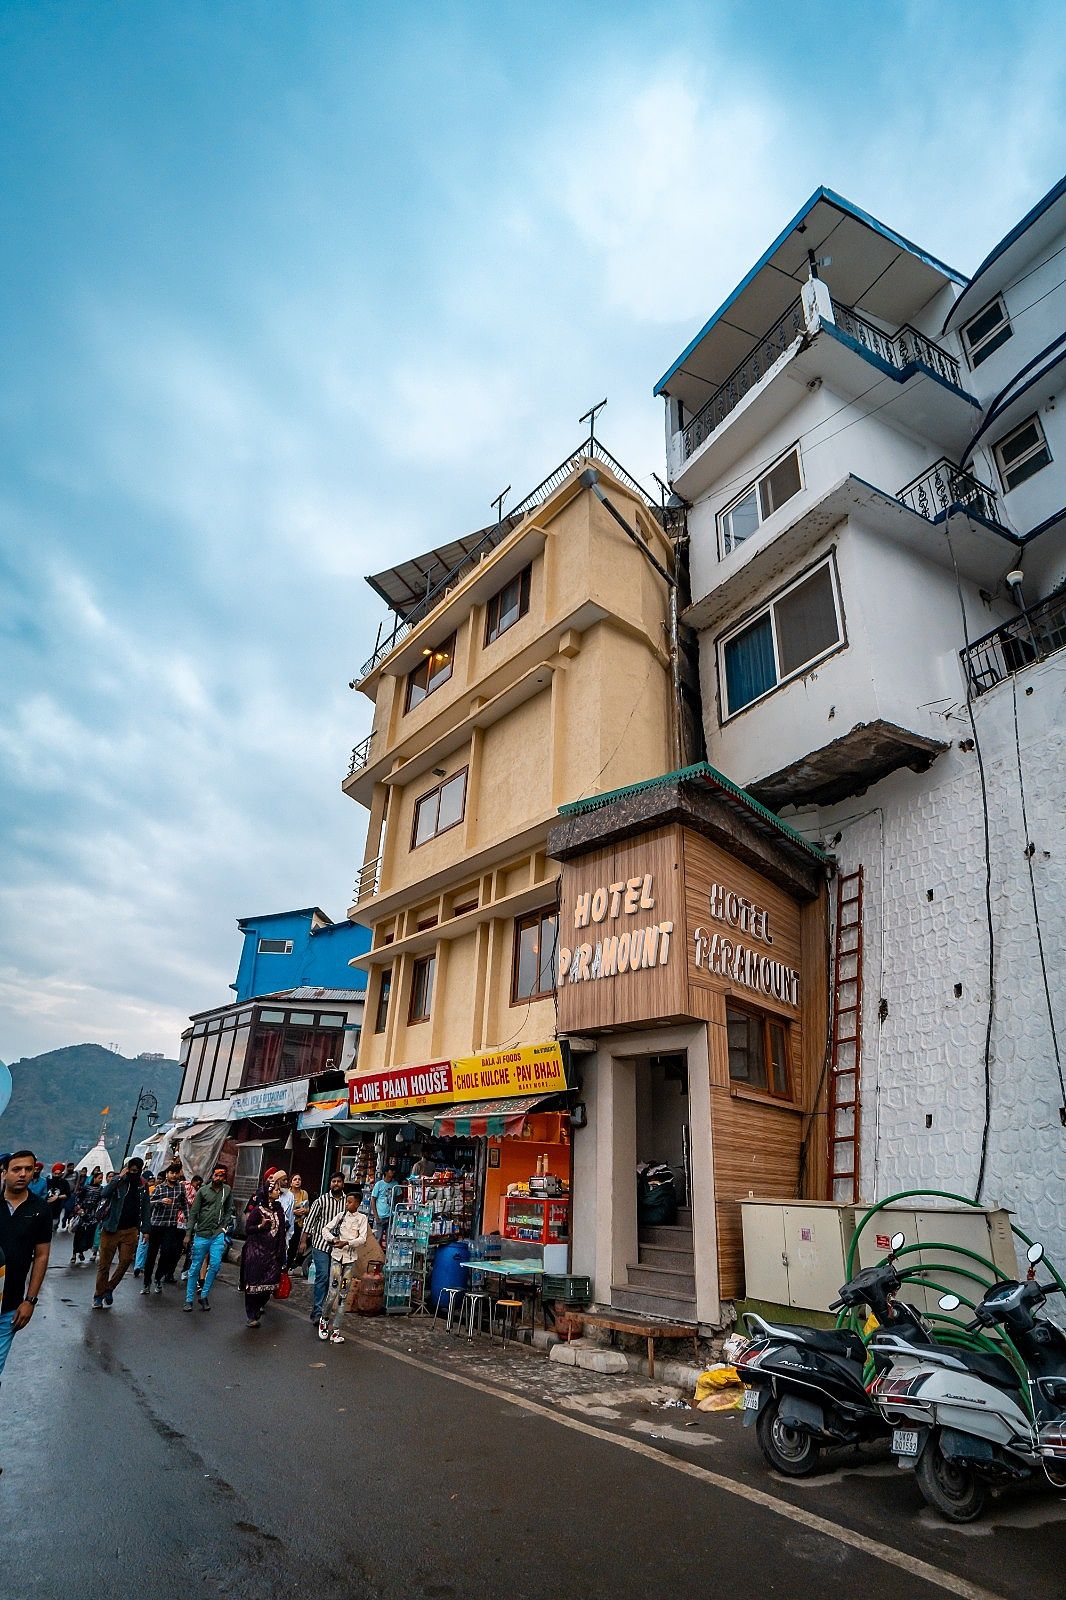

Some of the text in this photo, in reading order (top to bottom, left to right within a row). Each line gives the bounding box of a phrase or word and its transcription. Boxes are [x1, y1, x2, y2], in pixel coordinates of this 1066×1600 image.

[574, 873, 655, 929] HOTEL
[710, 883, 774, 945] HOTEL
[558, 920, 674, 987] PARAMOUNT
[694, 926, 801, 1006] PARAMOUNT
[353, 1070, 448, 1104] A-ONE PAAN HOUSE
[456, 1060, 560, 1090] CHOLE KULCHE PAV BHAJI
[482, 1053, 522, 1066] BALA JI FOODS
